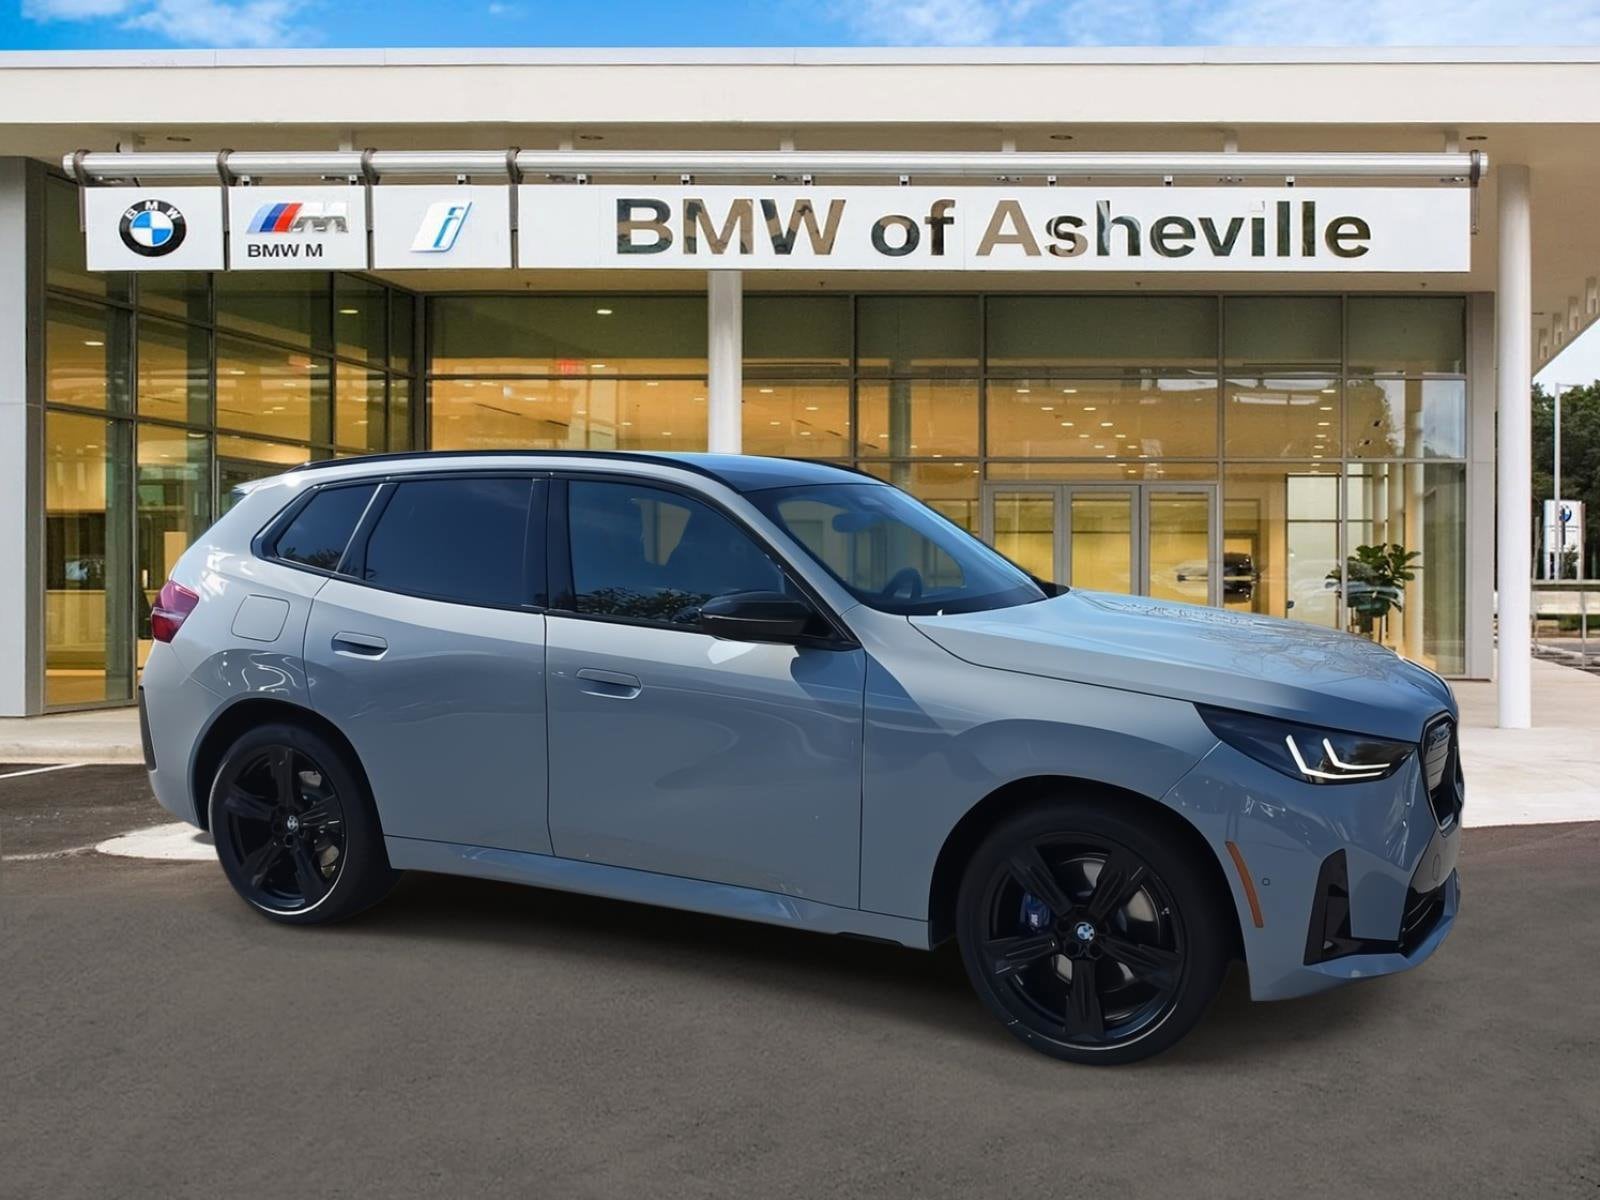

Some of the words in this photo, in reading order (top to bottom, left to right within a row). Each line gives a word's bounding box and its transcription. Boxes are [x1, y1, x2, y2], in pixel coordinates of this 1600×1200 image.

[124, 201, 181, 220] BMW
[616, 198, 847, 255] BMW
[871, 199, 956, 257] of
[975, 199, 1372, 258] Asheville
[247, 243, 300, 258] BMW
[305, 243, 323, 258] M
